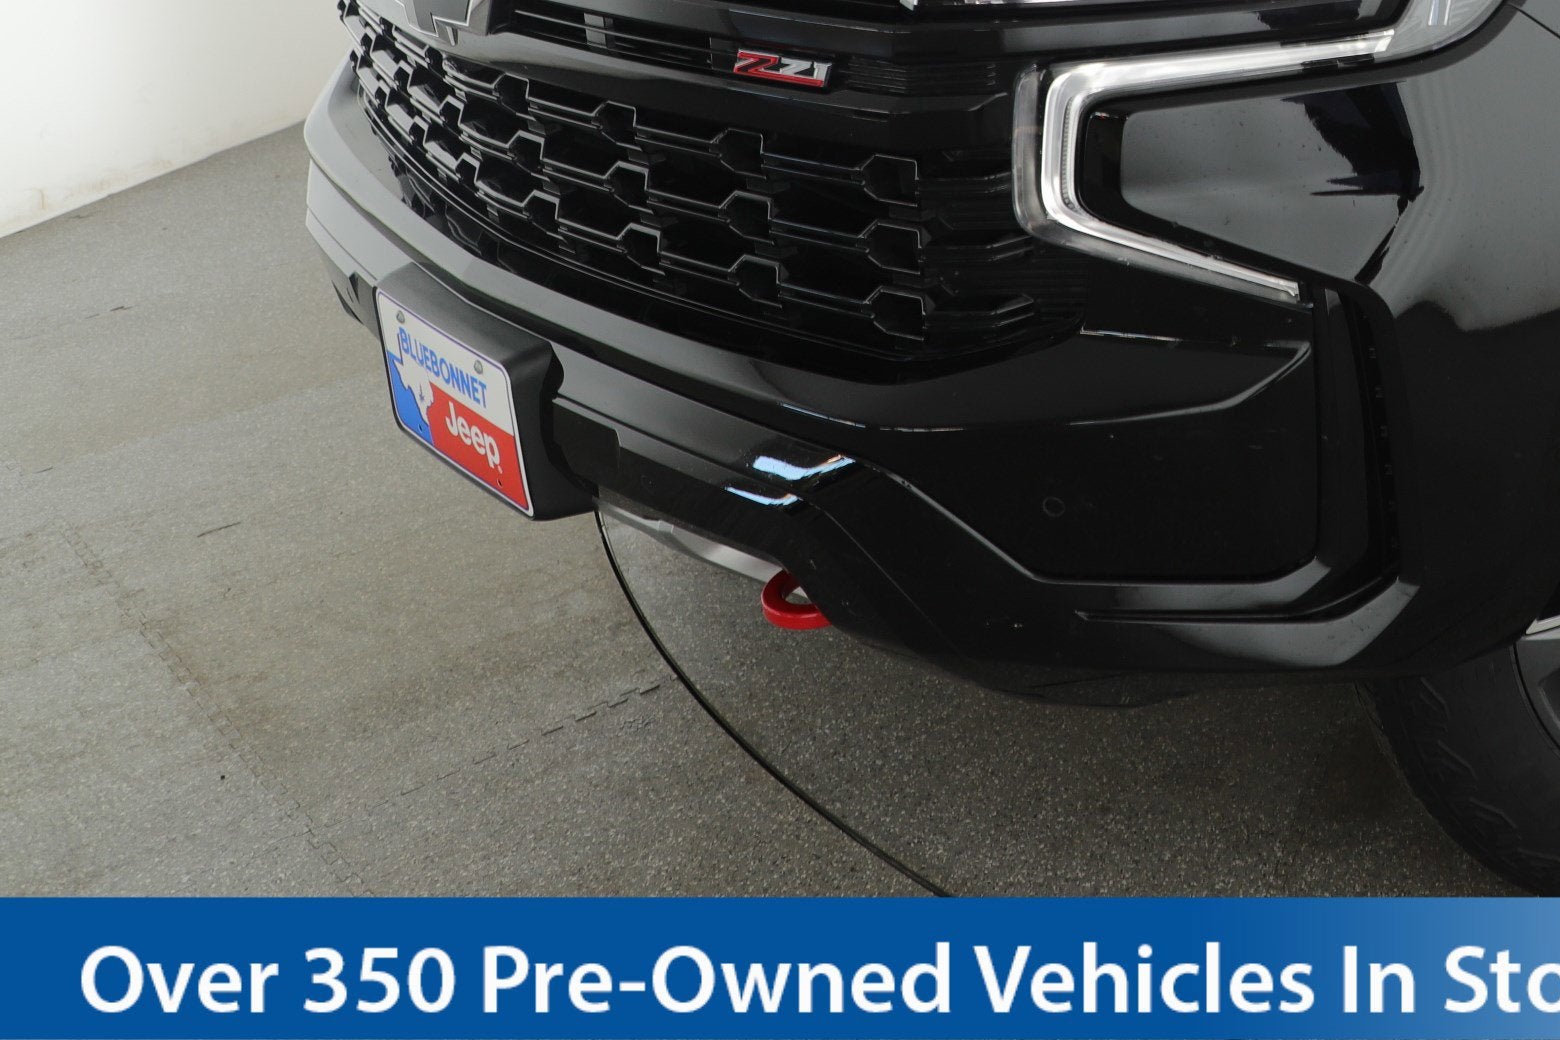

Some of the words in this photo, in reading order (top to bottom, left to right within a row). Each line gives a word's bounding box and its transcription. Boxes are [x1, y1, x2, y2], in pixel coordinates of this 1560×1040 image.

[733, 49, 832, 88] Z71
[398, 326, 488, 409] BLUEBONNET
[445, 401, 501, 469] Jeep
